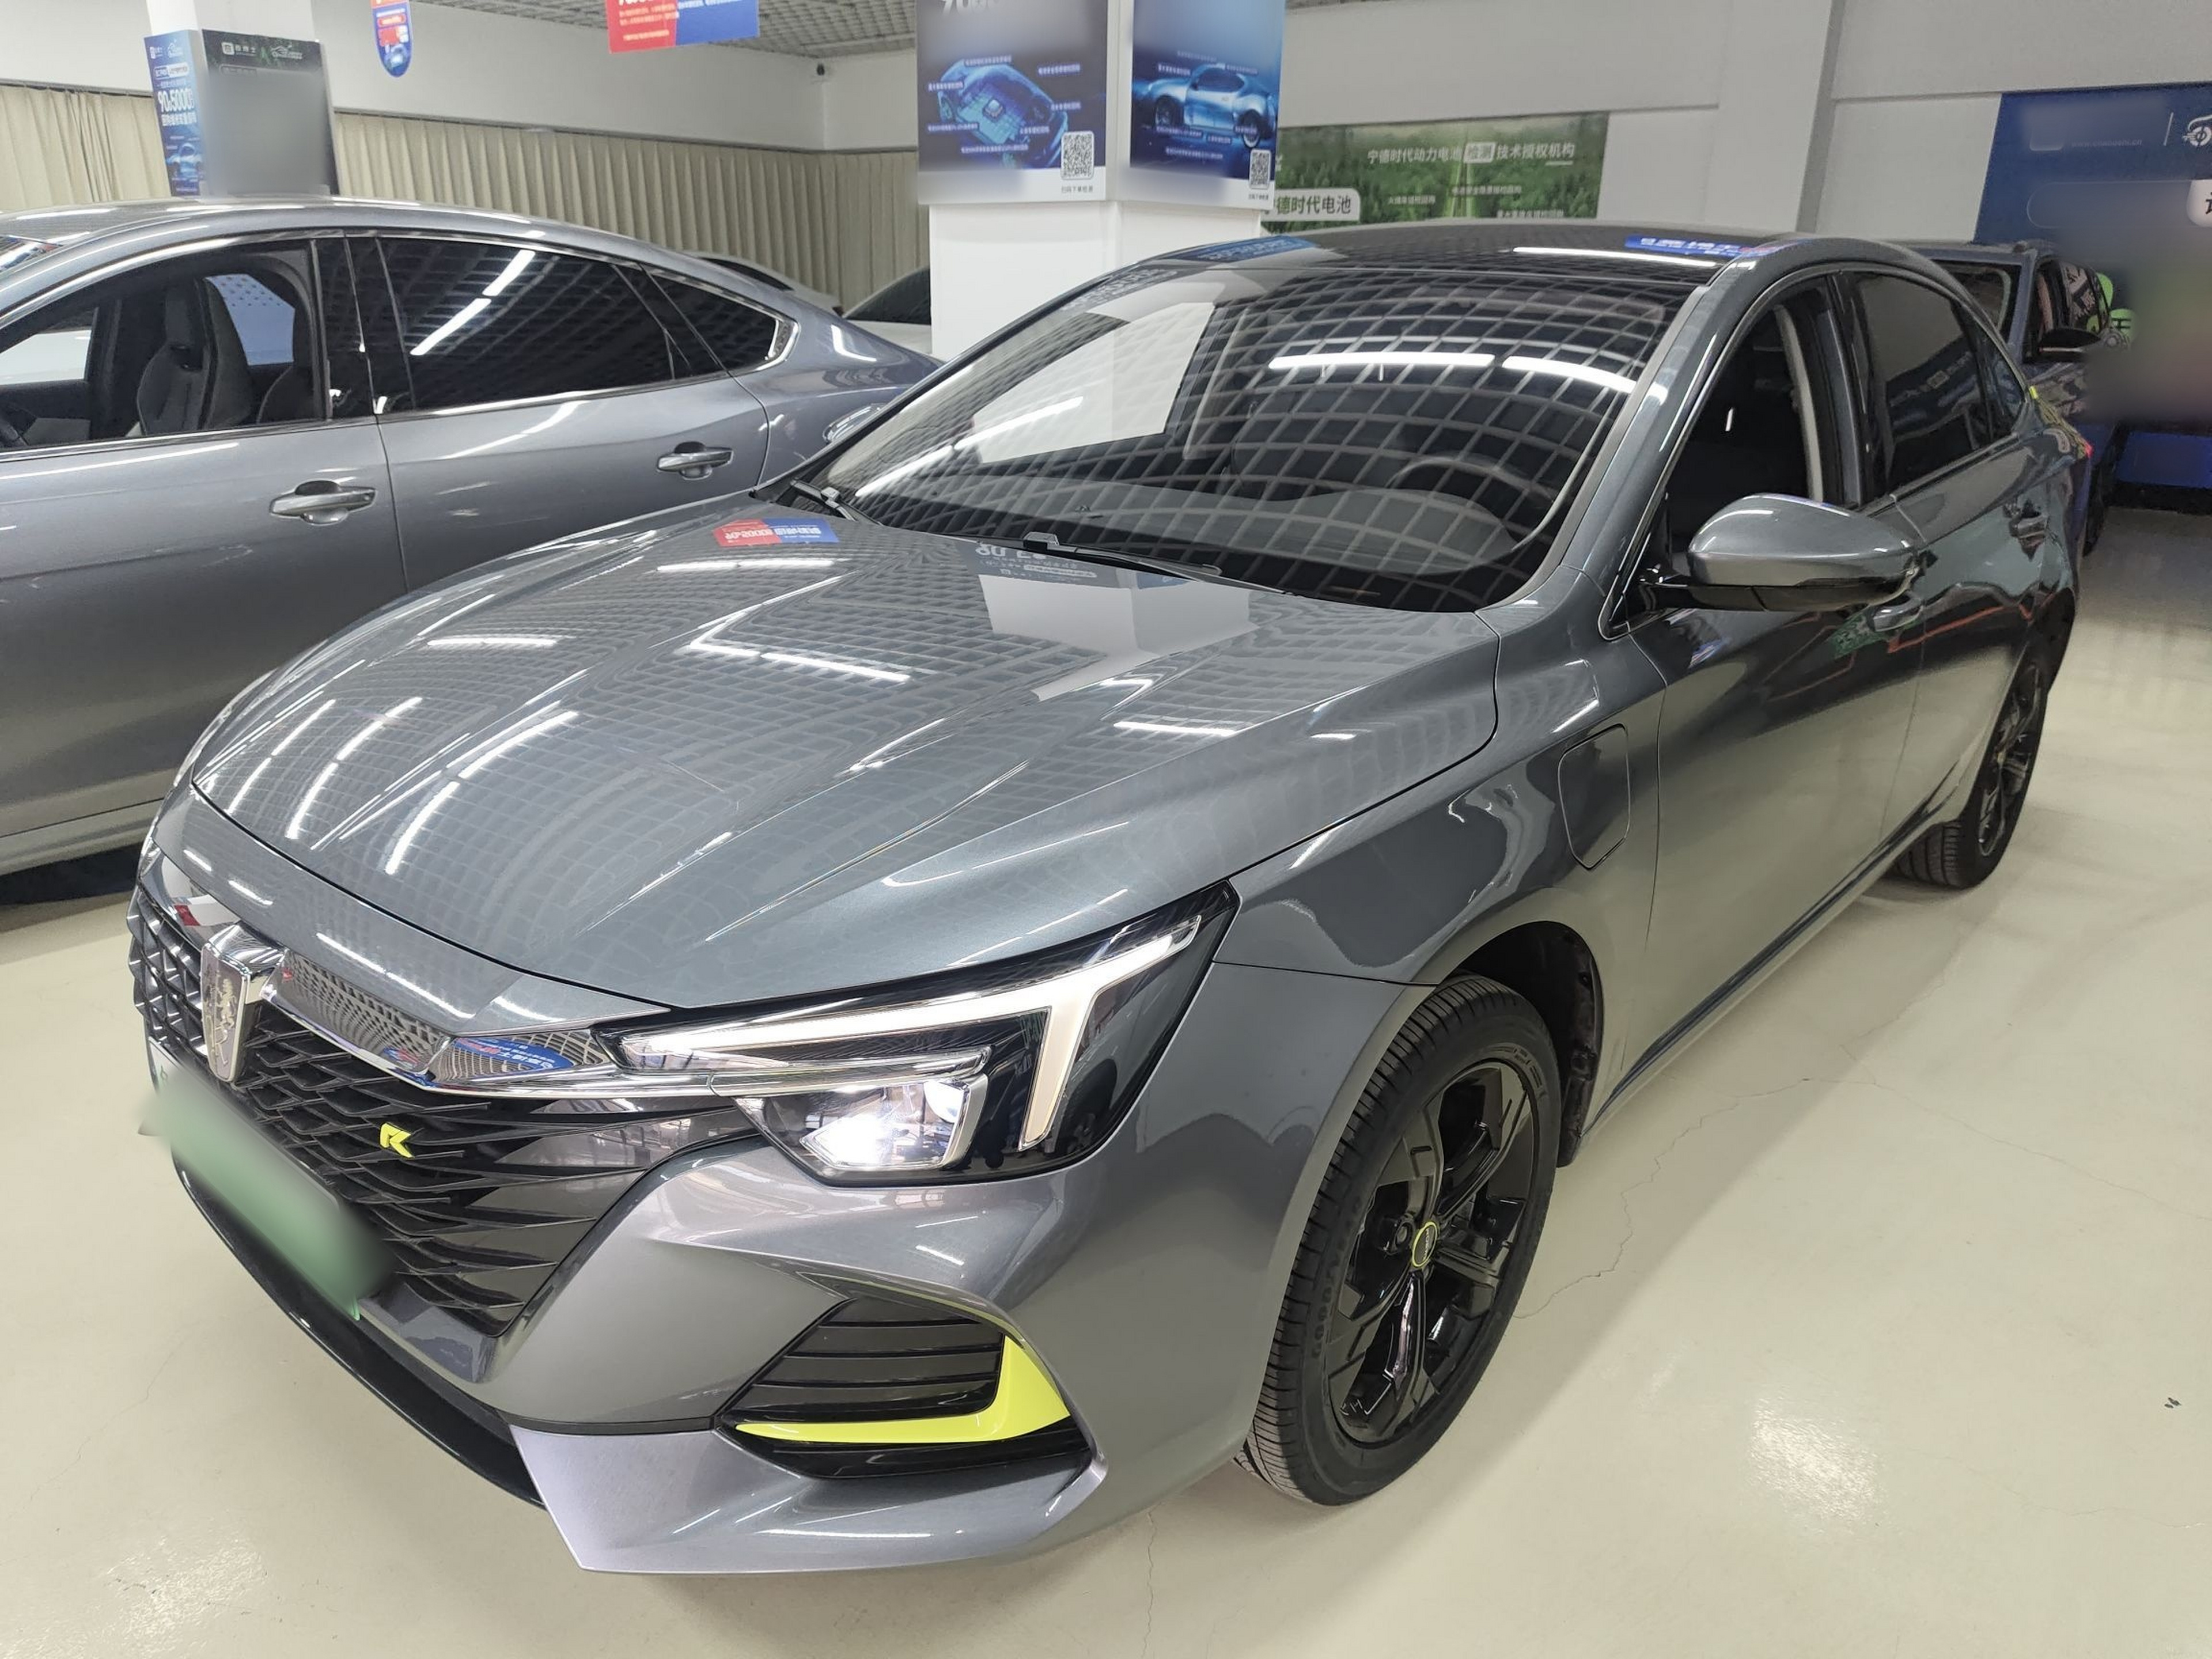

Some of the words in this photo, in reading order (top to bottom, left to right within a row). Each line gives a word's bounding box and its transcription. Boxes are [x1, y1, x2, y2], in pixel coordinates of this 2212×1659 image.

[1263, 195, 1351, 215] 德时代电池
